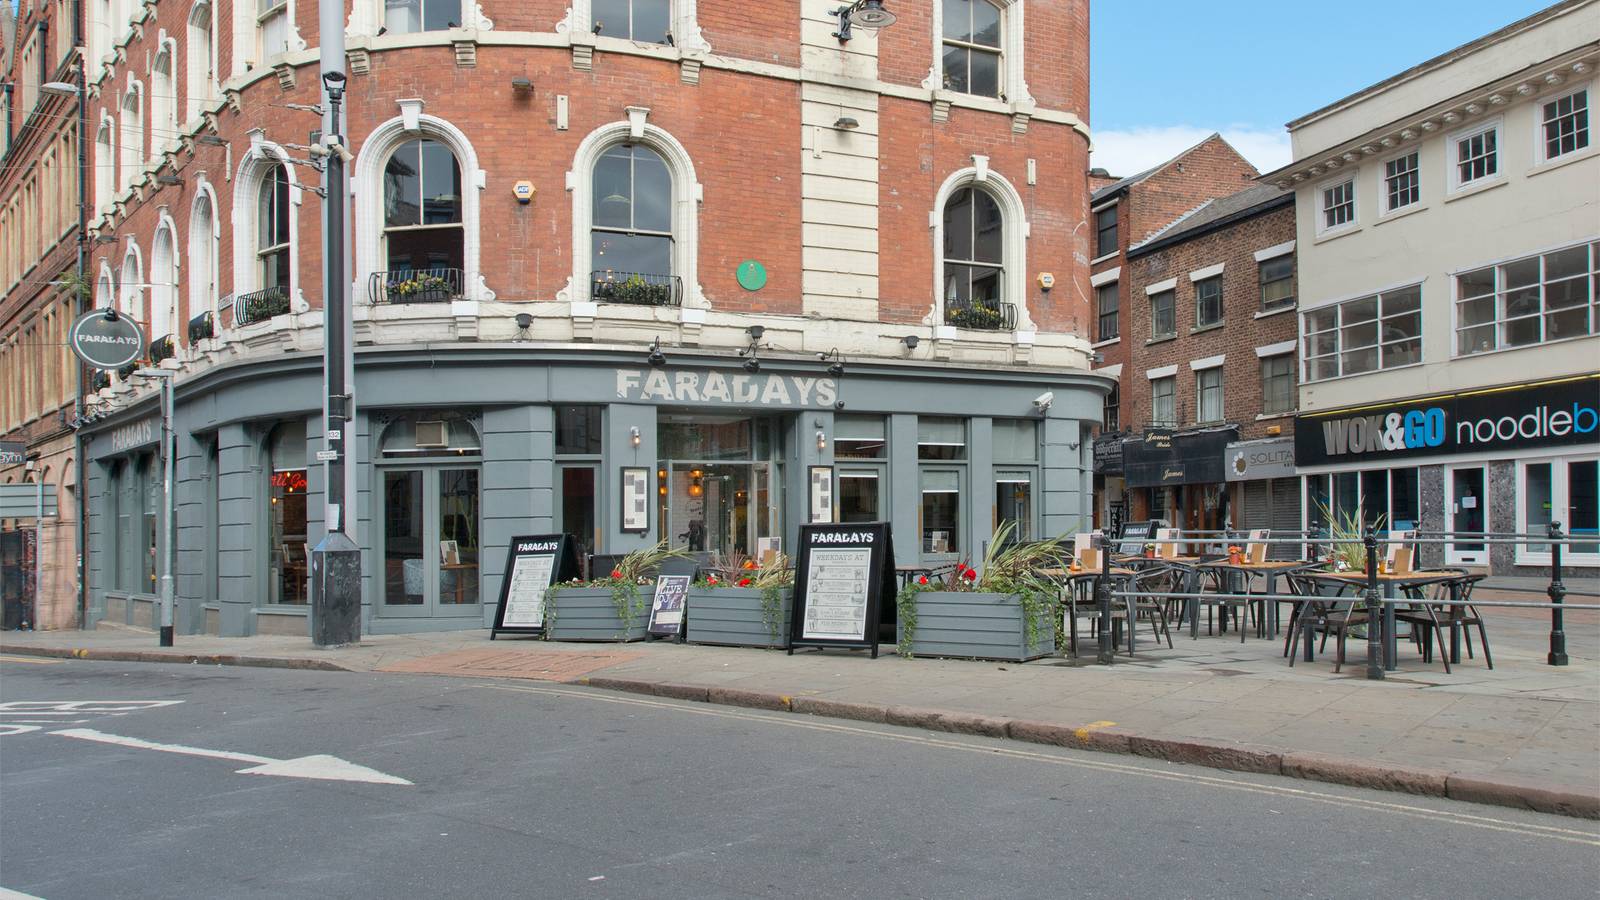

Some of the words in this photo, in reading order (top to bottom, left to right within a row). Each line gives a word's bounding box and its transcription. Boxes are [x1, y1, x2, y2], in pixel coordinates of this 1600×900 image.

[78, 334, 139, 345] FARADAYS
[616, 369, 836, 407] FARADAYS
[1456, 402, 1599, 445] noodleb
[112, 420, 151, 452] FARADAYS
[1145, 432, 1171, 442] James
[1322, 407, 1449, 456] WOK&GO
[1162, 468, 1184, 480] James
[811, 532, 874, 543] FARADAYS
[518, 542, 558, 552] FARADAYS
